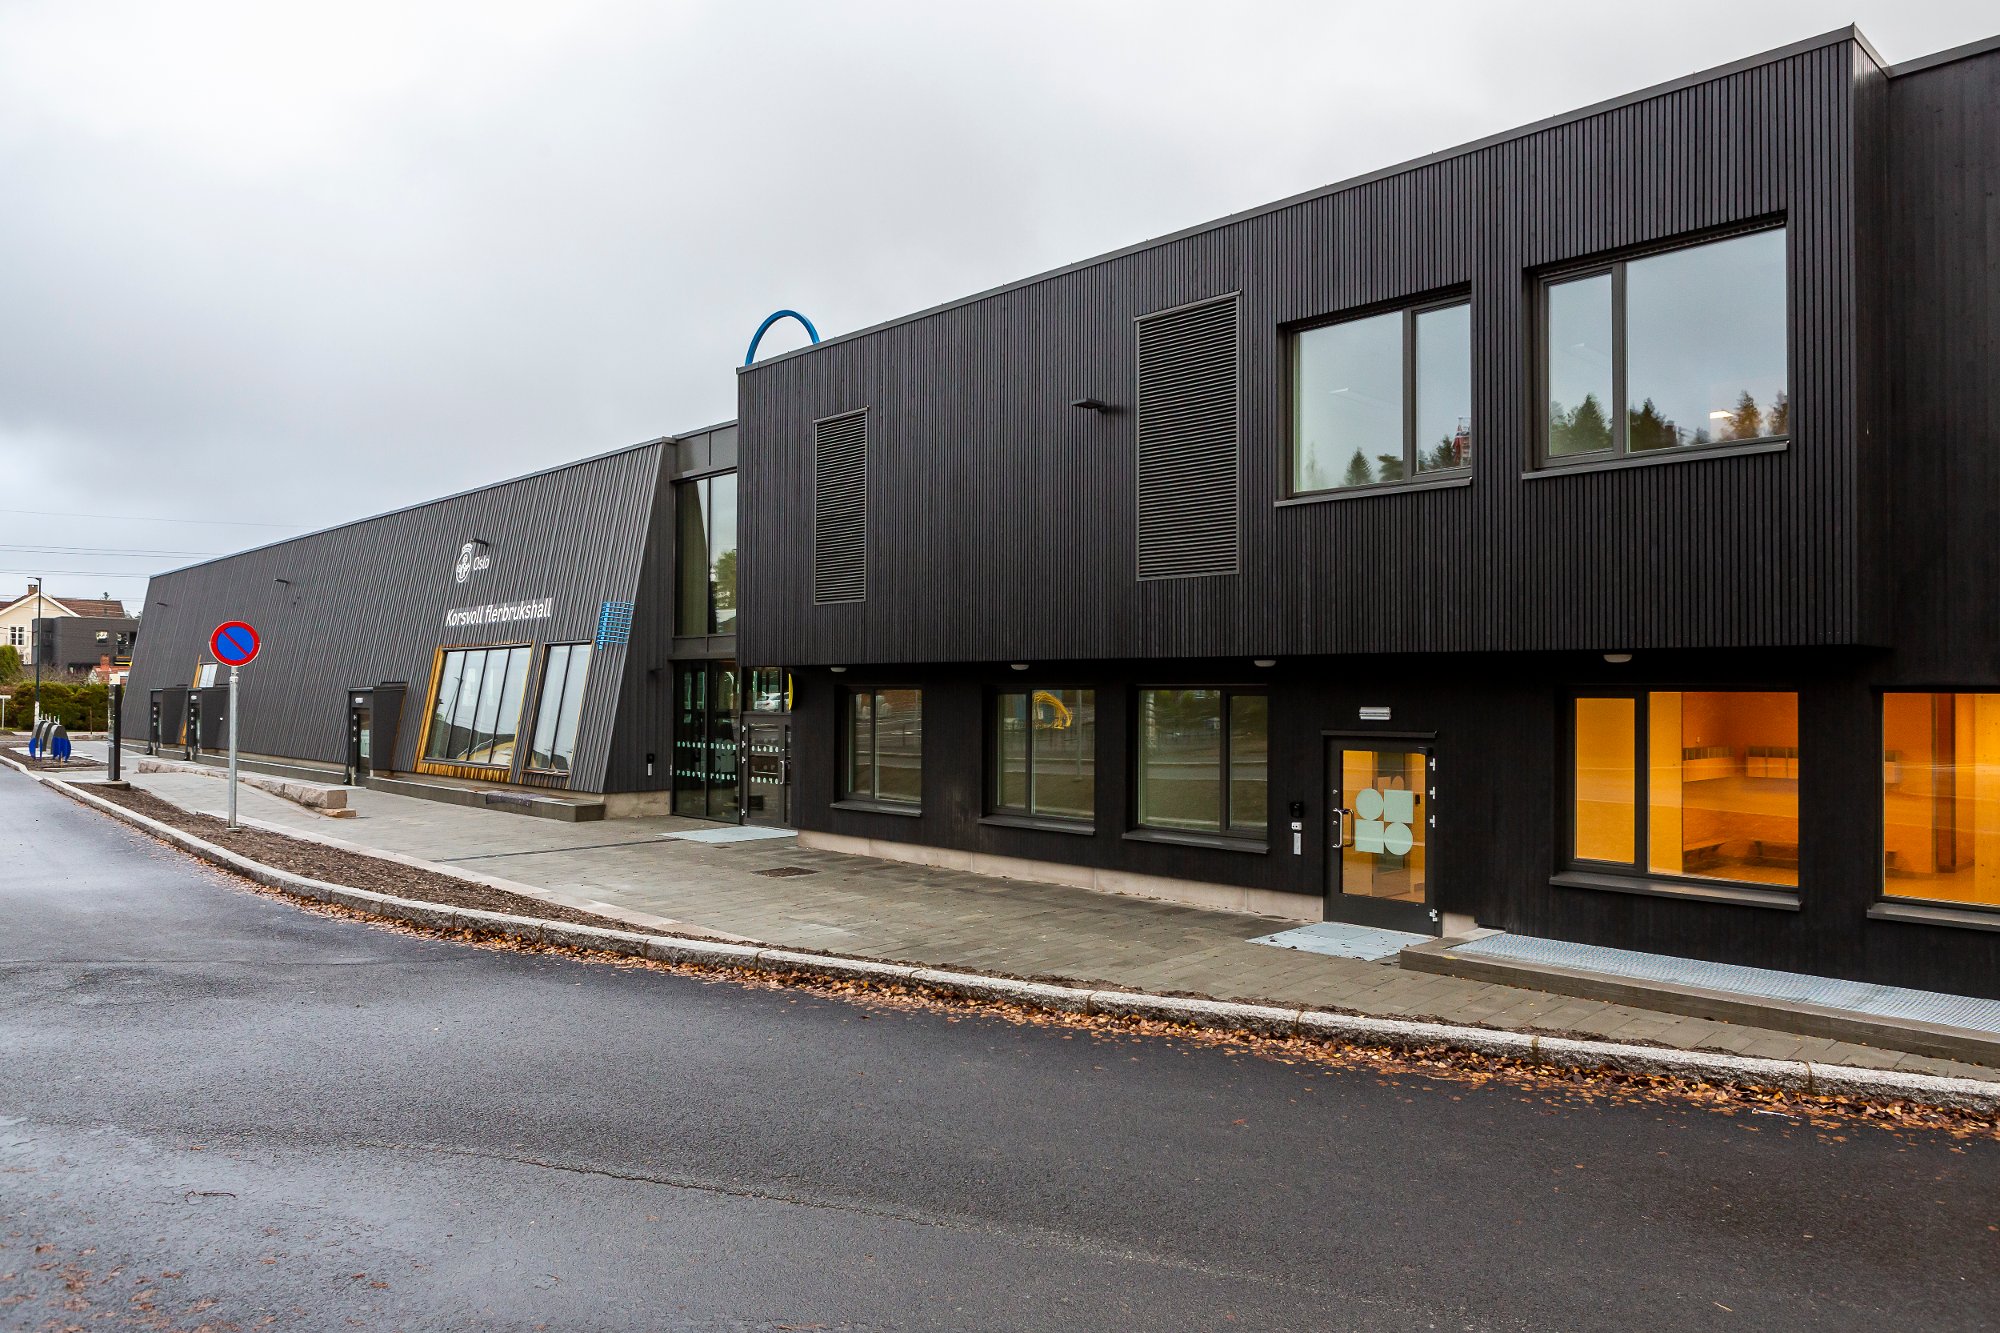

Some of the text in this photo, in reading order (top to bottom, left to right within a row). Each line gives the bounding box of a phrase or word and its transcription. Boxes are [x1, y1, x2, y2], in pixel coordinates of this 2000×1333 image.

[473, 556, 489, 570] Oslo
[445, 598, 552, 627] Korsvoll flerbrukshall
